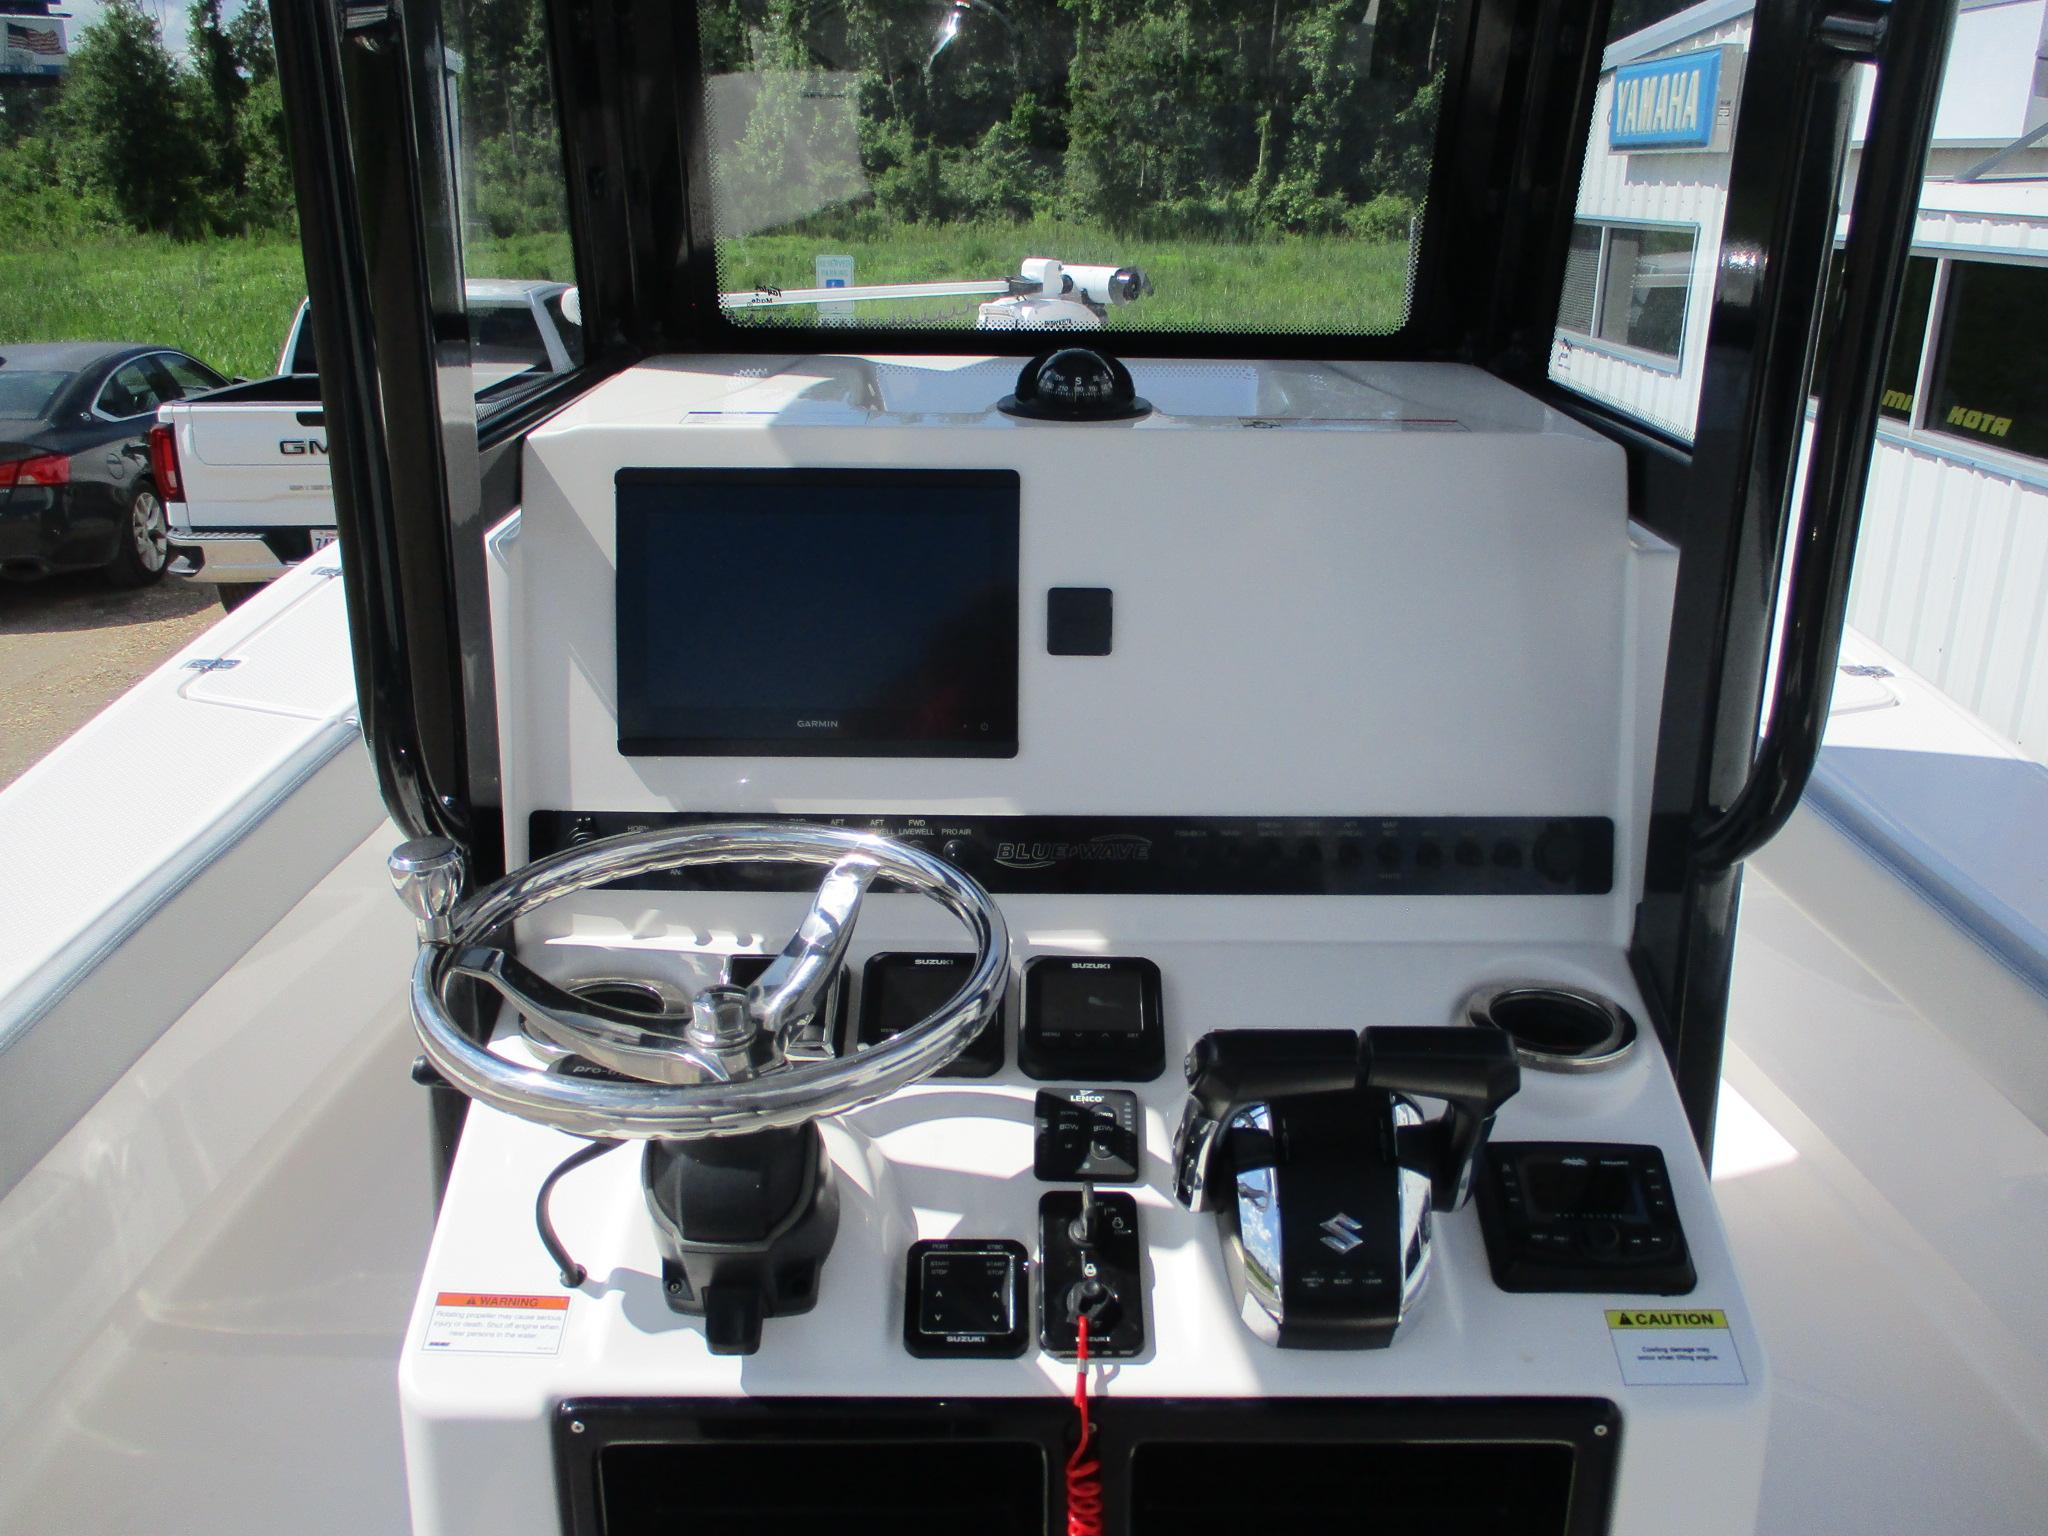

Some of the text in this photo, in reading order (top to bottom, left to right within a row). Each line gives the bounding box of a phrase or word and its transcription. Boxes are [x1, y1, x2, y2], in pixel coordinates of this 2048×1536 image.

[1616, 70, 1700, 136] YAMAHA
[1946, 405, 2013, 437] KOTA
[279, 440, 329, 455] GM
[796, 720, 838, 728] GARMIN
[908, 819, 926, 827] FWD
[898, 828, 935, 836] LIVEWELL
[941, 828, 972, 836] PRO AIR
[995, 842, 1150, 860] BLUE WAVE
[480, 1297, 539, 1307] WARNING
[466, 1312, 497, 1320] propeller
[1635, 1313, 1714, 1325] CAUTION
